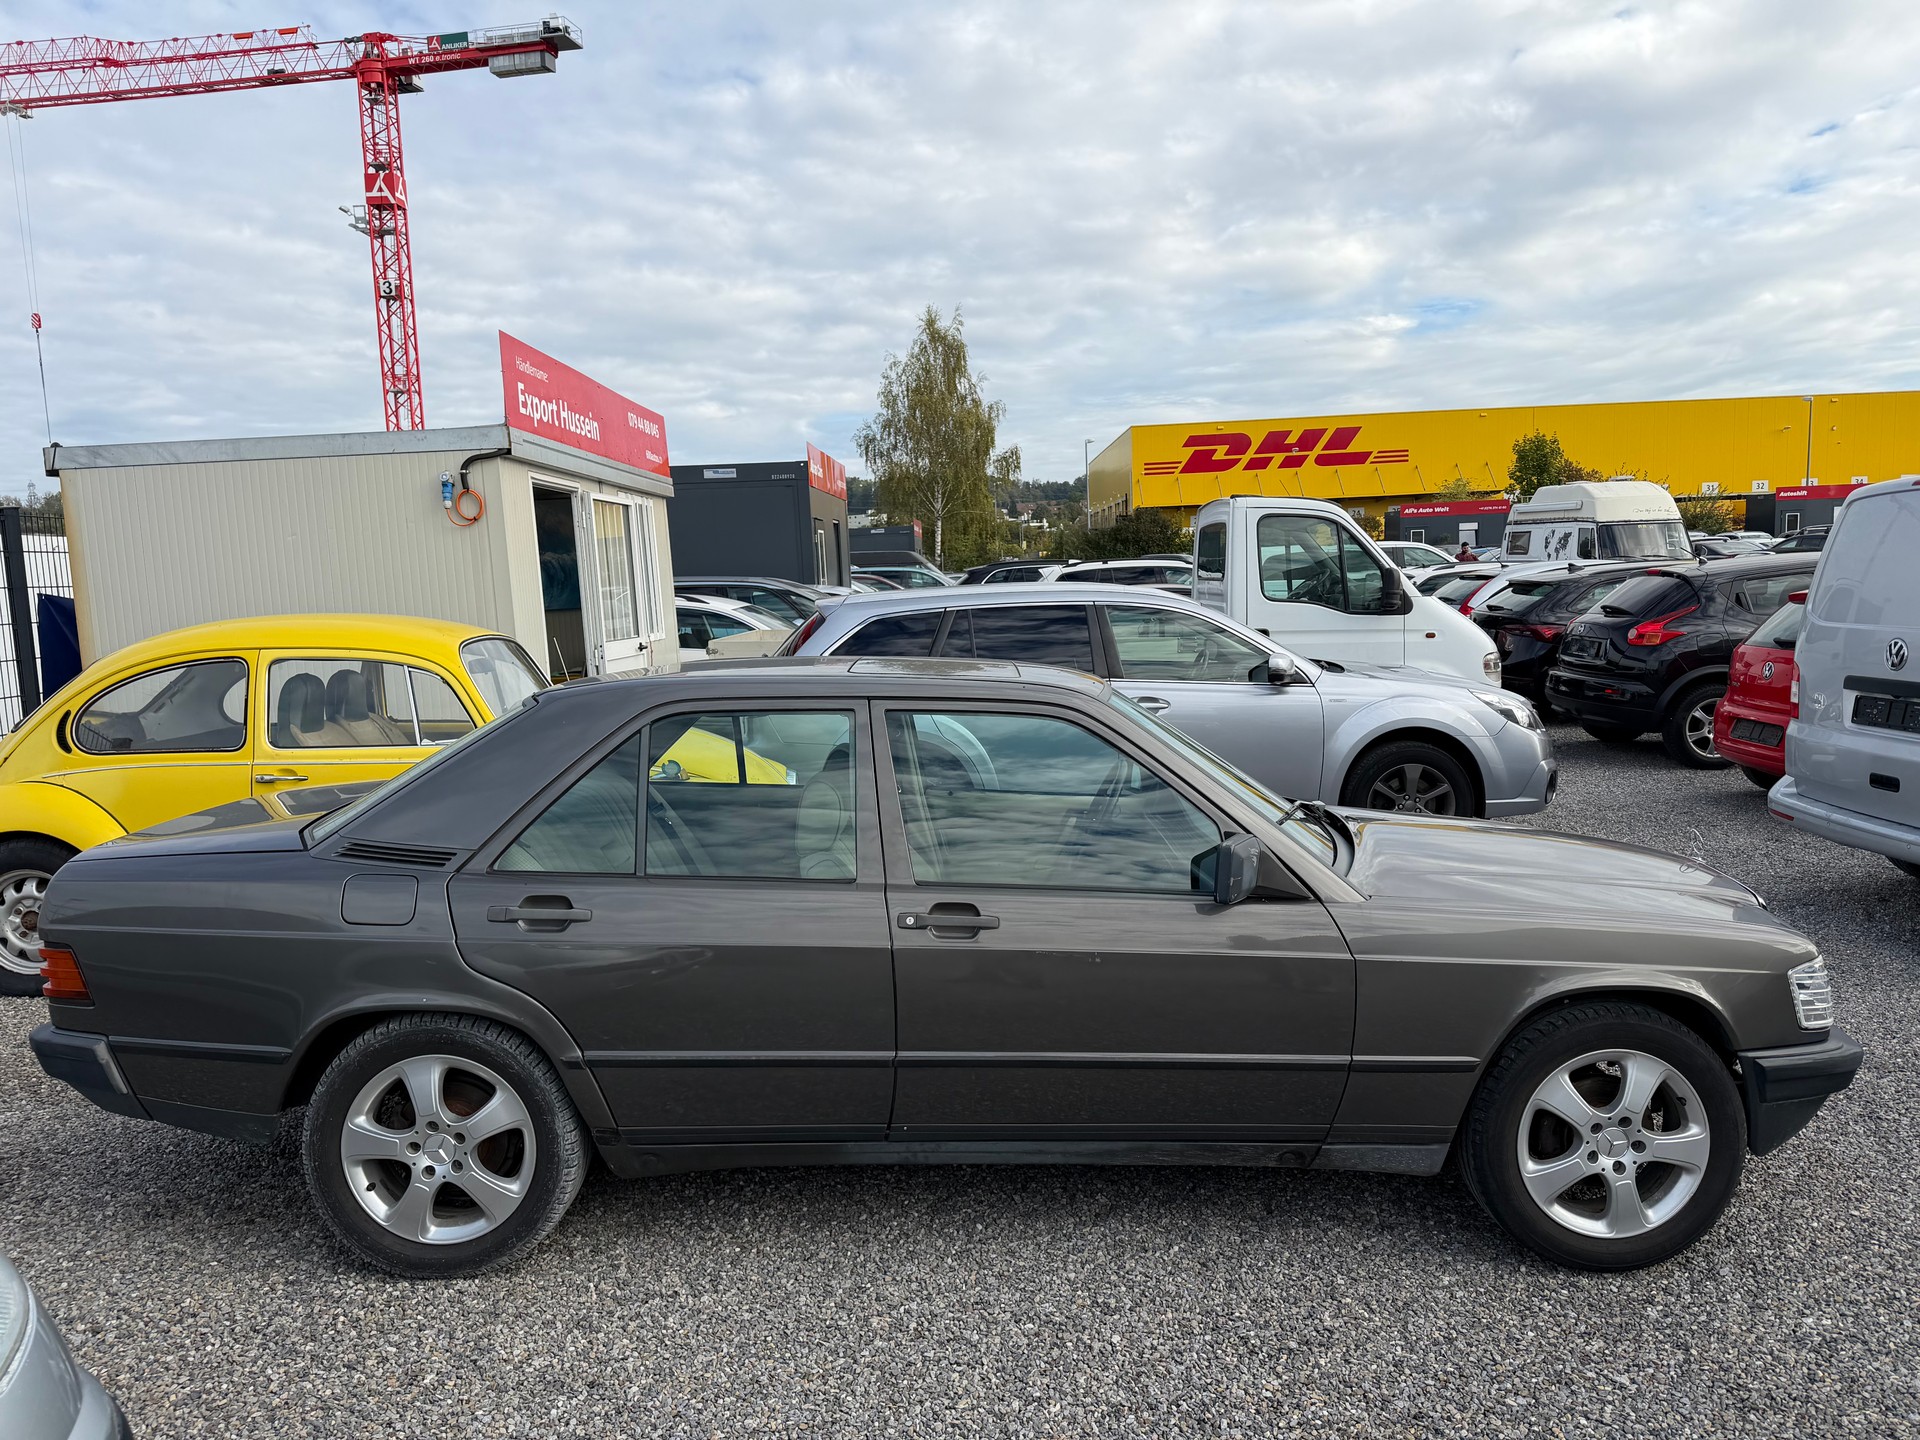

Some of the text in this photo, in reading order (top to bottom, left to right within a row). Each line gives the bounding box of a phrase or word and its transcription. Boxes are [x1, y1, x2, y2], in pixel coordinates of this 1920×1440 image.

[441, 41, 468, 50] ANLIKER
[408, 57, 420, 65] WT
[421, 55, 434, 63] 260
[383, 281, 393, 295] 3
[517, 381, 600, 441] Export Hussein
[1178, 426, 1374, 474] DHL
[1756, 482, 1765, 490] 32
